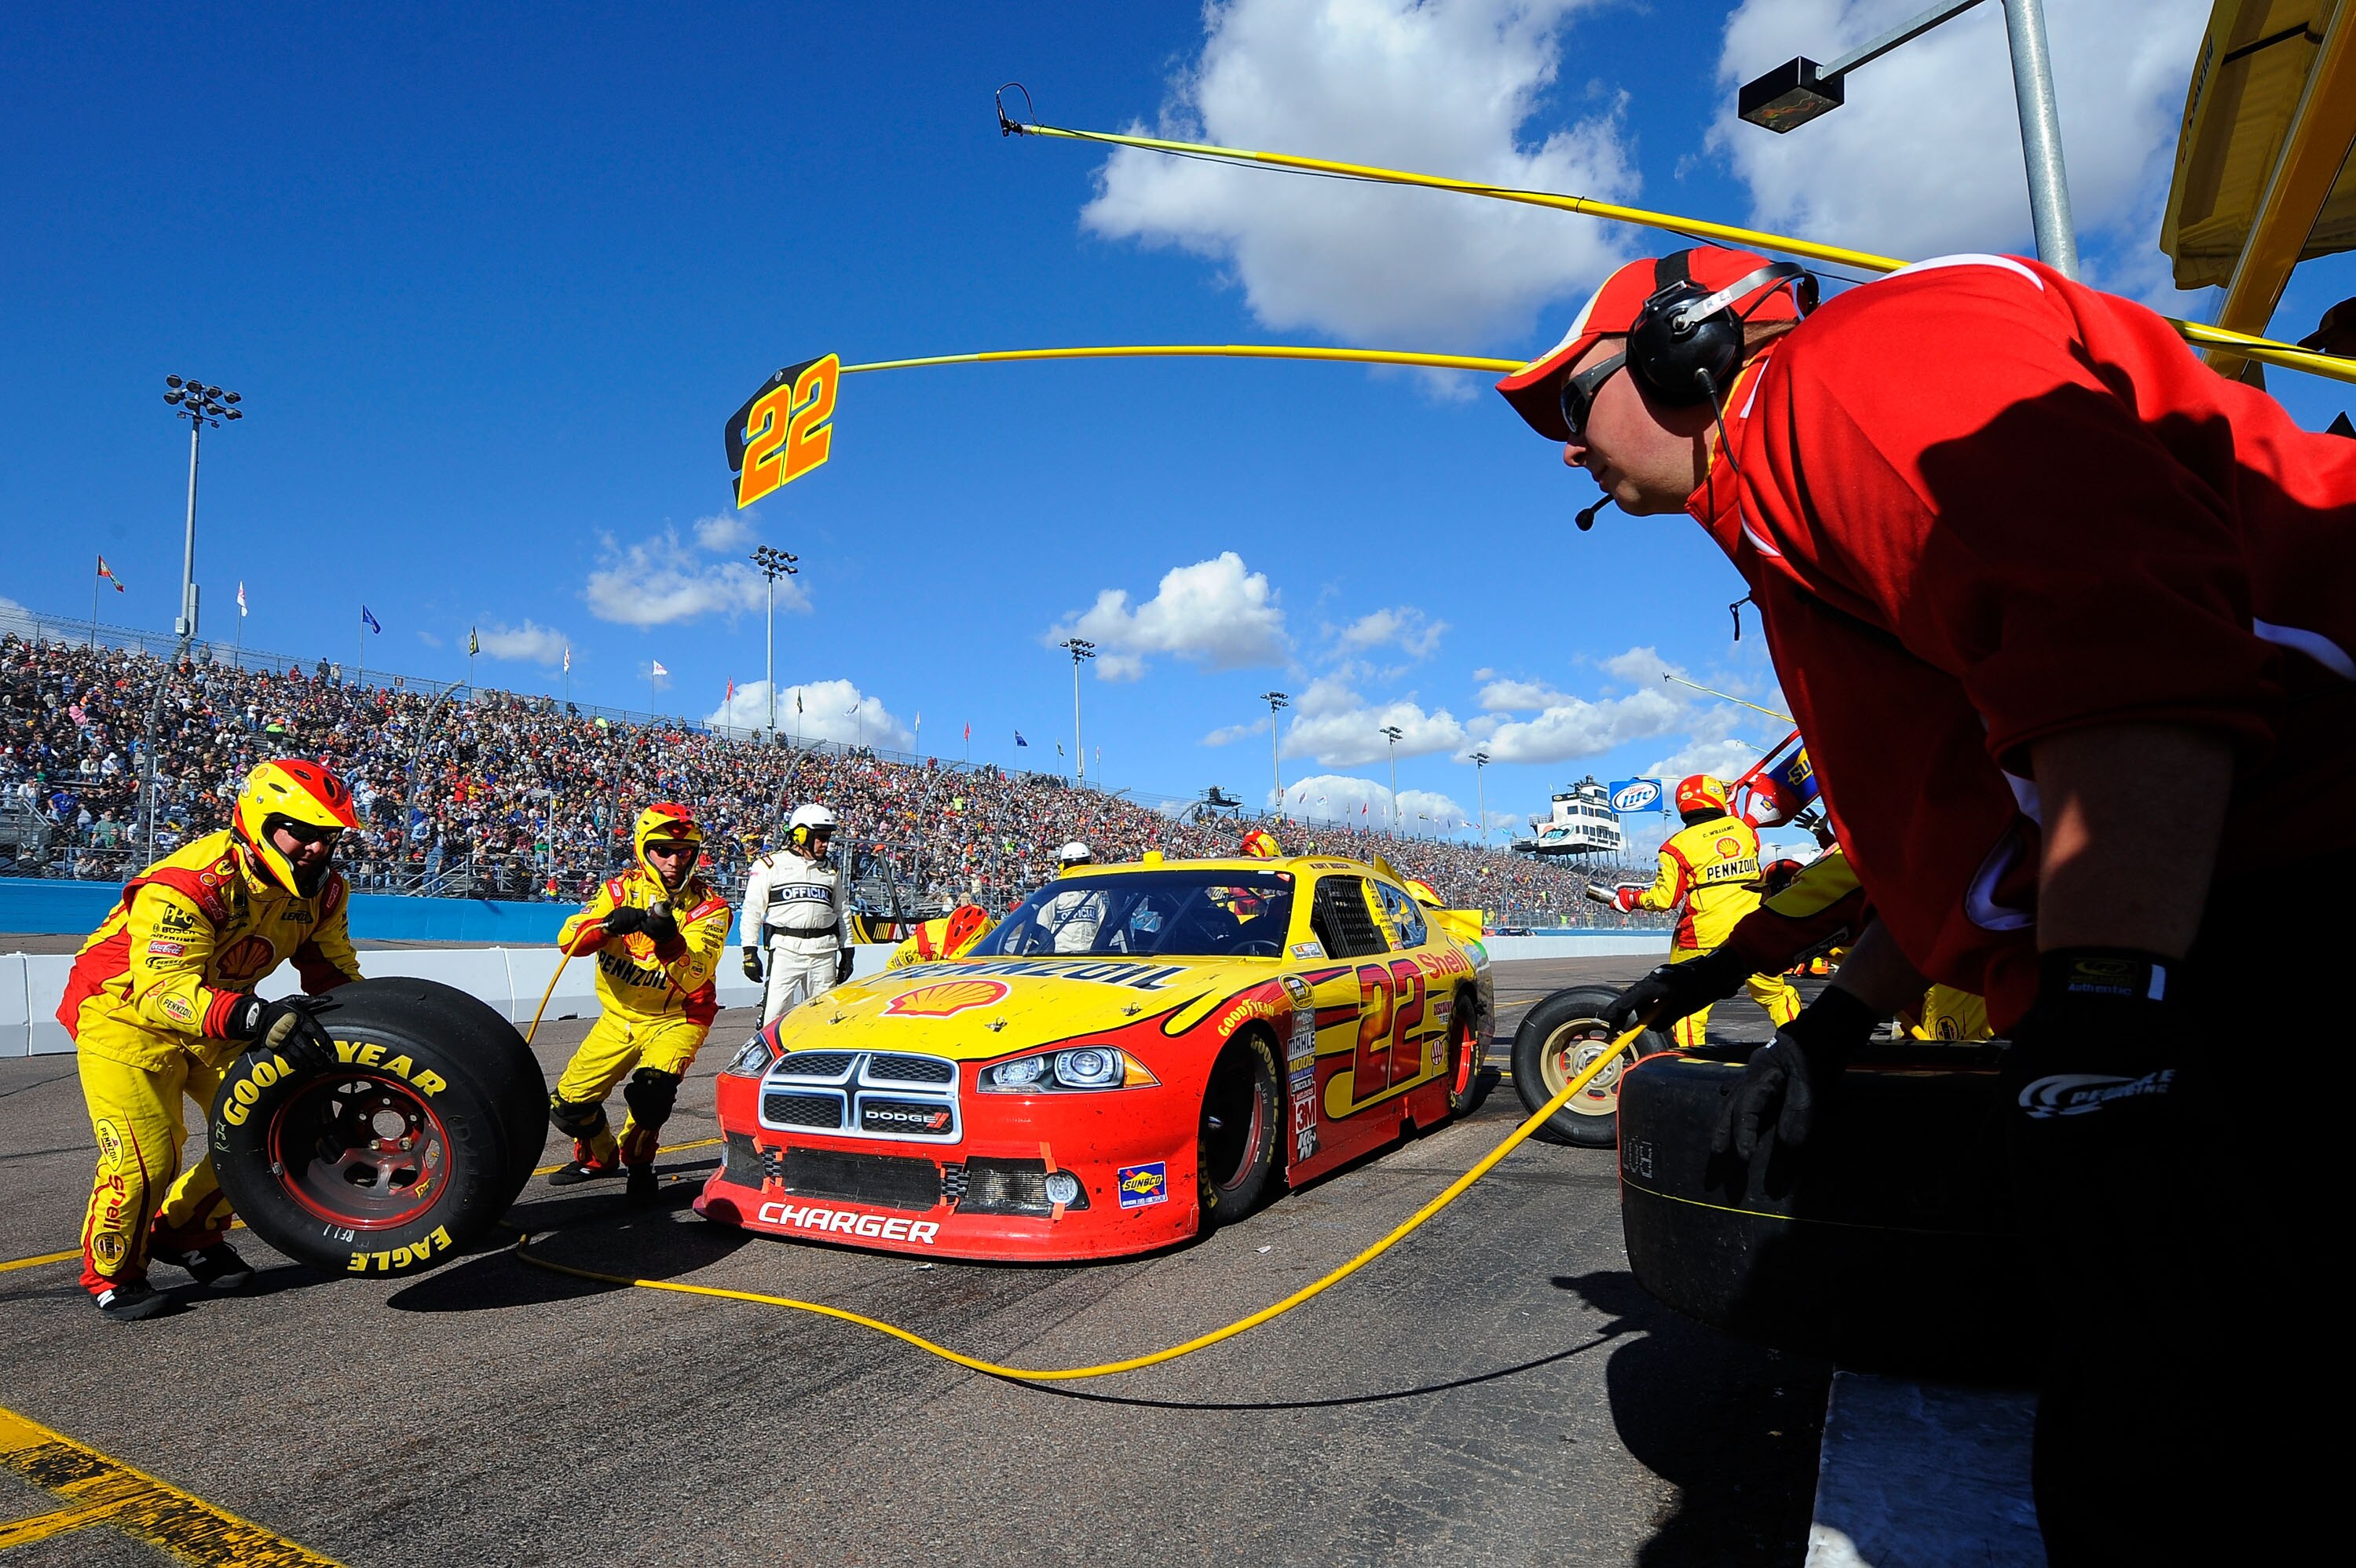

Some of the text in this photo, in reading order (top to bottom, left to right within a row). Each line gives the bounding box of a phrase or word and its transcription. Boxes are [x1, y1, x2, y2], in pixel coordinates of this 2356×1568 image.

[736, 352, 840, 510] 22
[1622, 789, 1653, 809] Lite
[1544, 829, 1564, 841] PIR
[1707, 858, 1757, 880] PENNZOIL
[782, 886, 829, 901] OFFICIAL
[598, 950, 668, 991] PENNZOIL
[1417, 948, 1468, 980] Shell
[2066, 982, 2134, 996] Authentic
[162, 998, 193, 1021] PENNZOIL
[1217, 998, 1275, 1037] GOODYEAR
[1288, 1032, 1315, 1058] MAHLE
[1352, 958, 1426, 1107] 22
[1289, 1053, 1315, 1073] MOOG
[865, 1110, 937, 1124] DODGE
[1297, 1098, 1316, 1131] 3M
[101, 1127, 119, 1164] PENNZOIL
[1124, 1175, 1162, 1190] SUNOCO
[104, 1175, 126, 1230] Shell
[758, 1201, 941, 1245] CHARGER
[347, 1224, 452, 1272] EAGLE
